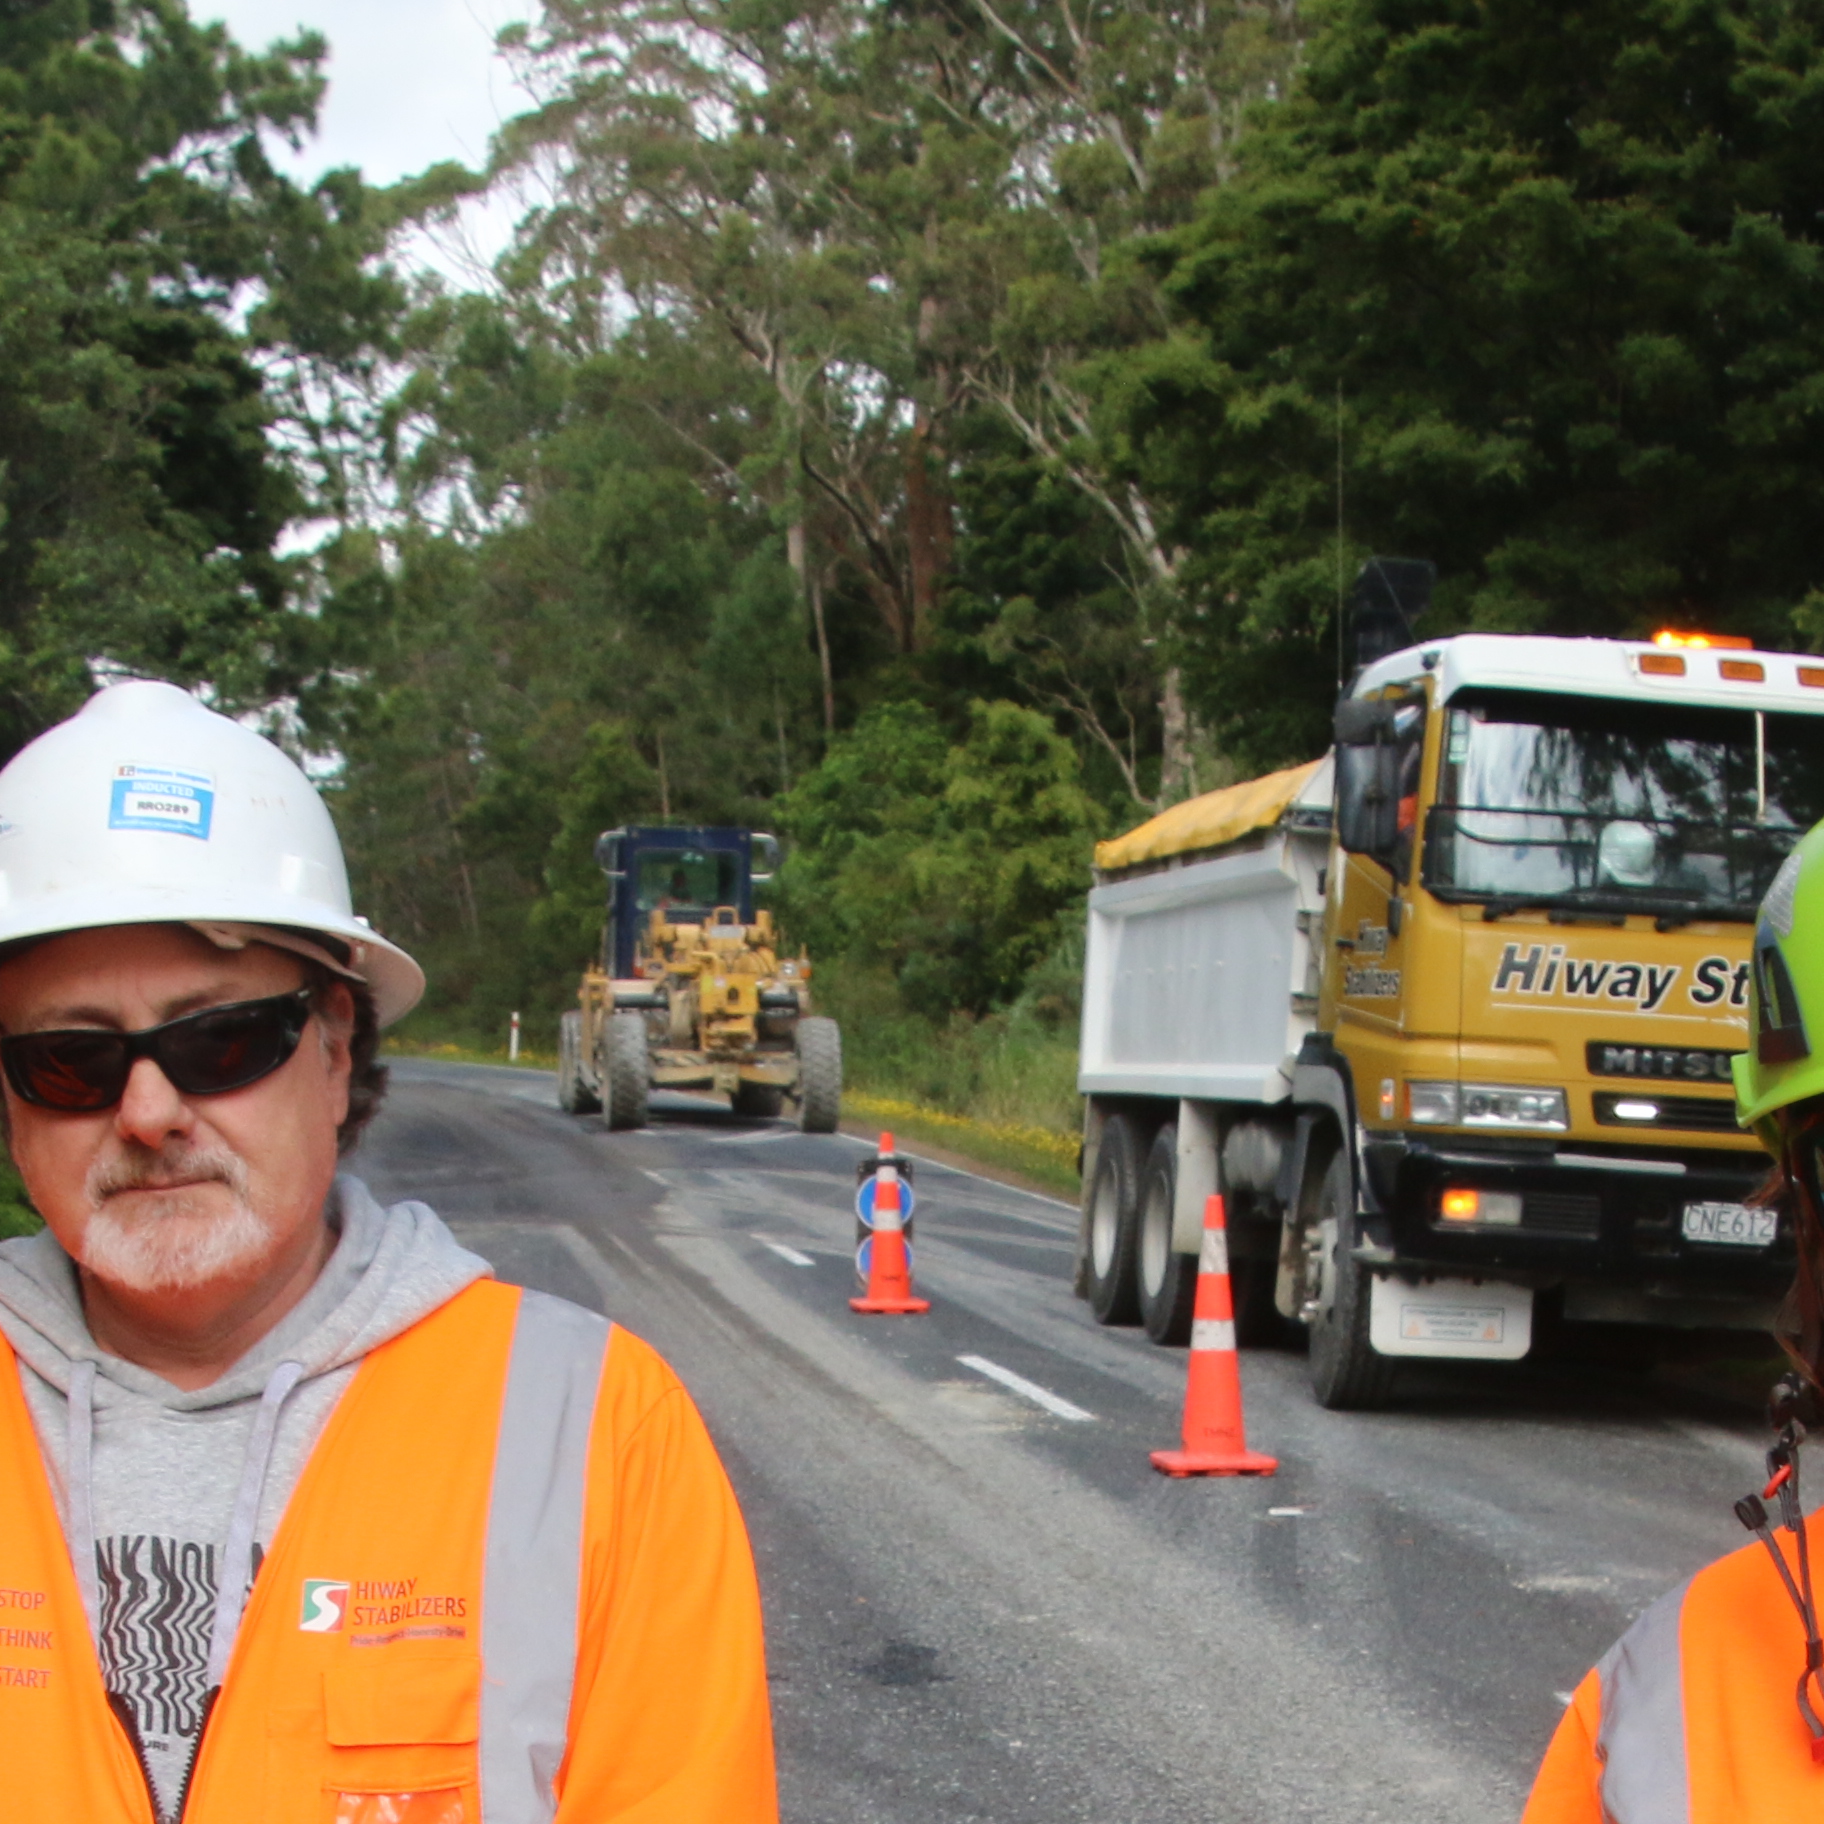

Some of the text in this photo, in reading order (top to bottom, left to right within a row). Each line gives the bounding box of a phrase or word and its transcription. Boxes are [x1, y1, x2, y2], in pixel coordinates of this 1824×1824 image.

[131, 781, 195, 797] INDUCTED
[1492, 943, 1679, 1012] Hiway
[1686, 1208, 1775, 1238] CNE612
[356, 1578, 418, 1600] HIWAY
[353, 1597, 467, 1627] STABILIZERS
